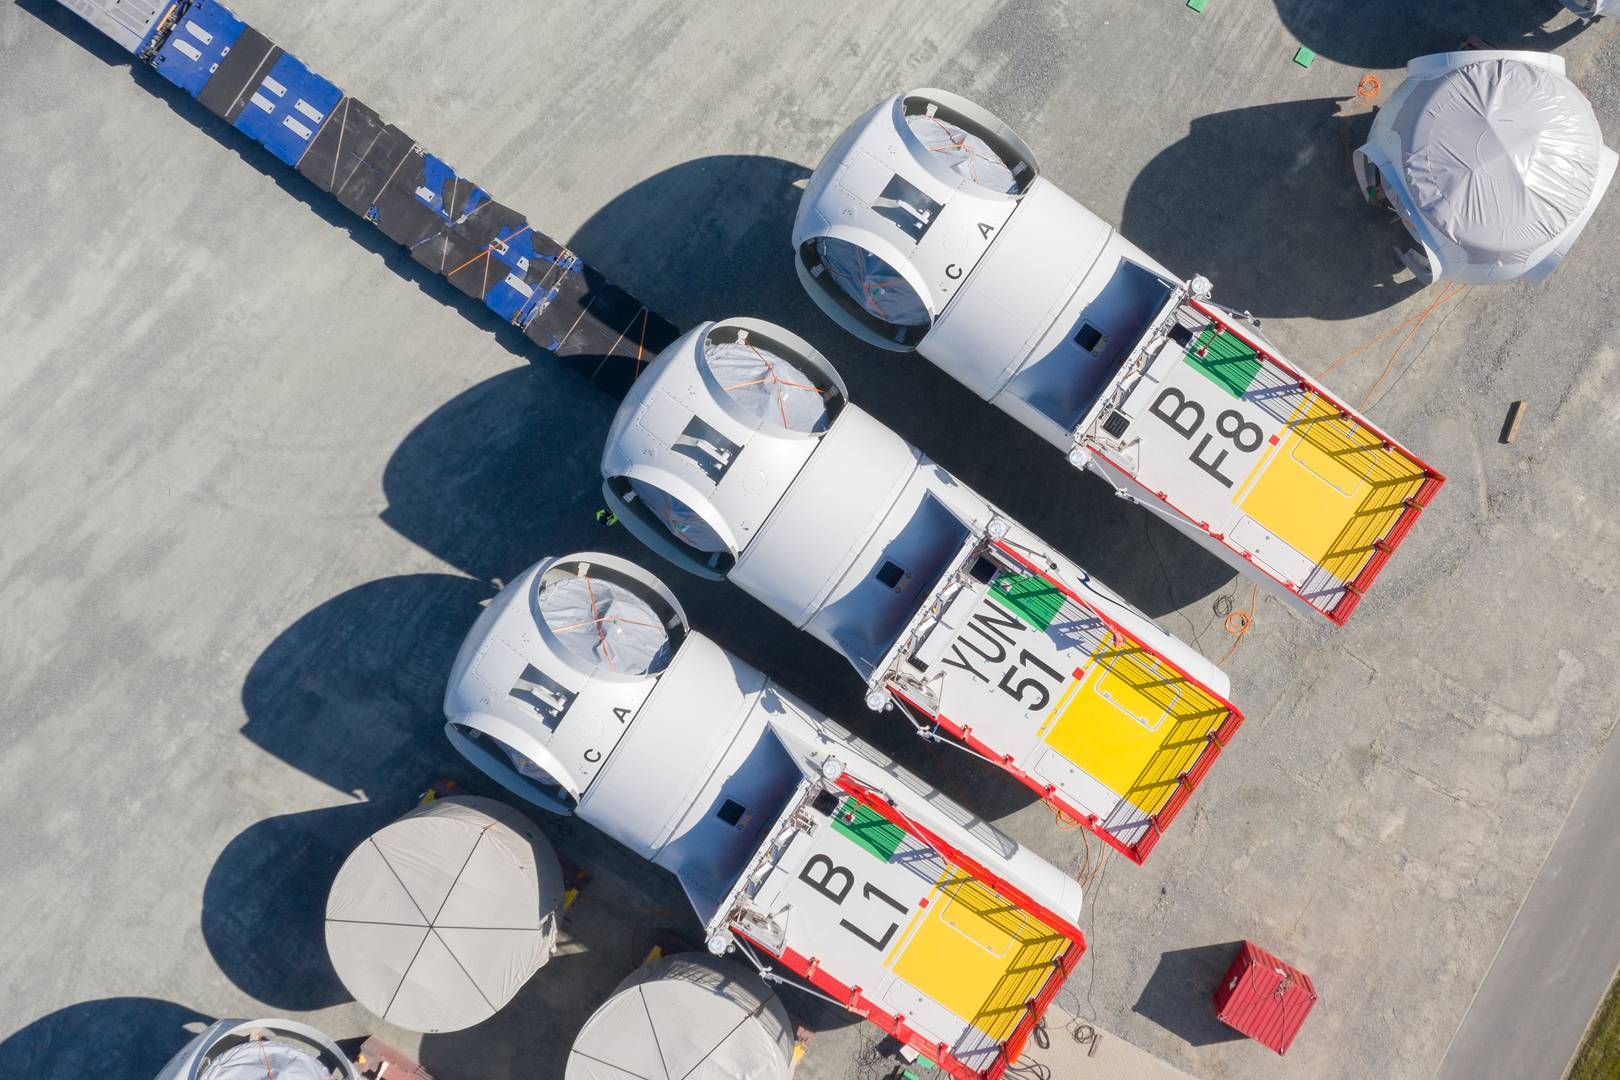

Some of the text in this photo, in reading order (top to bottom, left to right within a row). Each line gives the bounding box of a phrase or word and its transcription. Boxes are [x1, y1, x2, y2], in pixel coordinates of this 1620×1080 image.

[945, 263, 962, 280] C
[1148, 387, 1205, 440] B
[1188, 409, 1263, 488] F8
[941, 598, 1027, 684] YUN
[997, 648, 1065, 711] 51
[612, 707, 632, 724] A
[583, 748, 601, 763] C
[798, 853, 855, 906] B
[839, 881, 909, 952] L1
